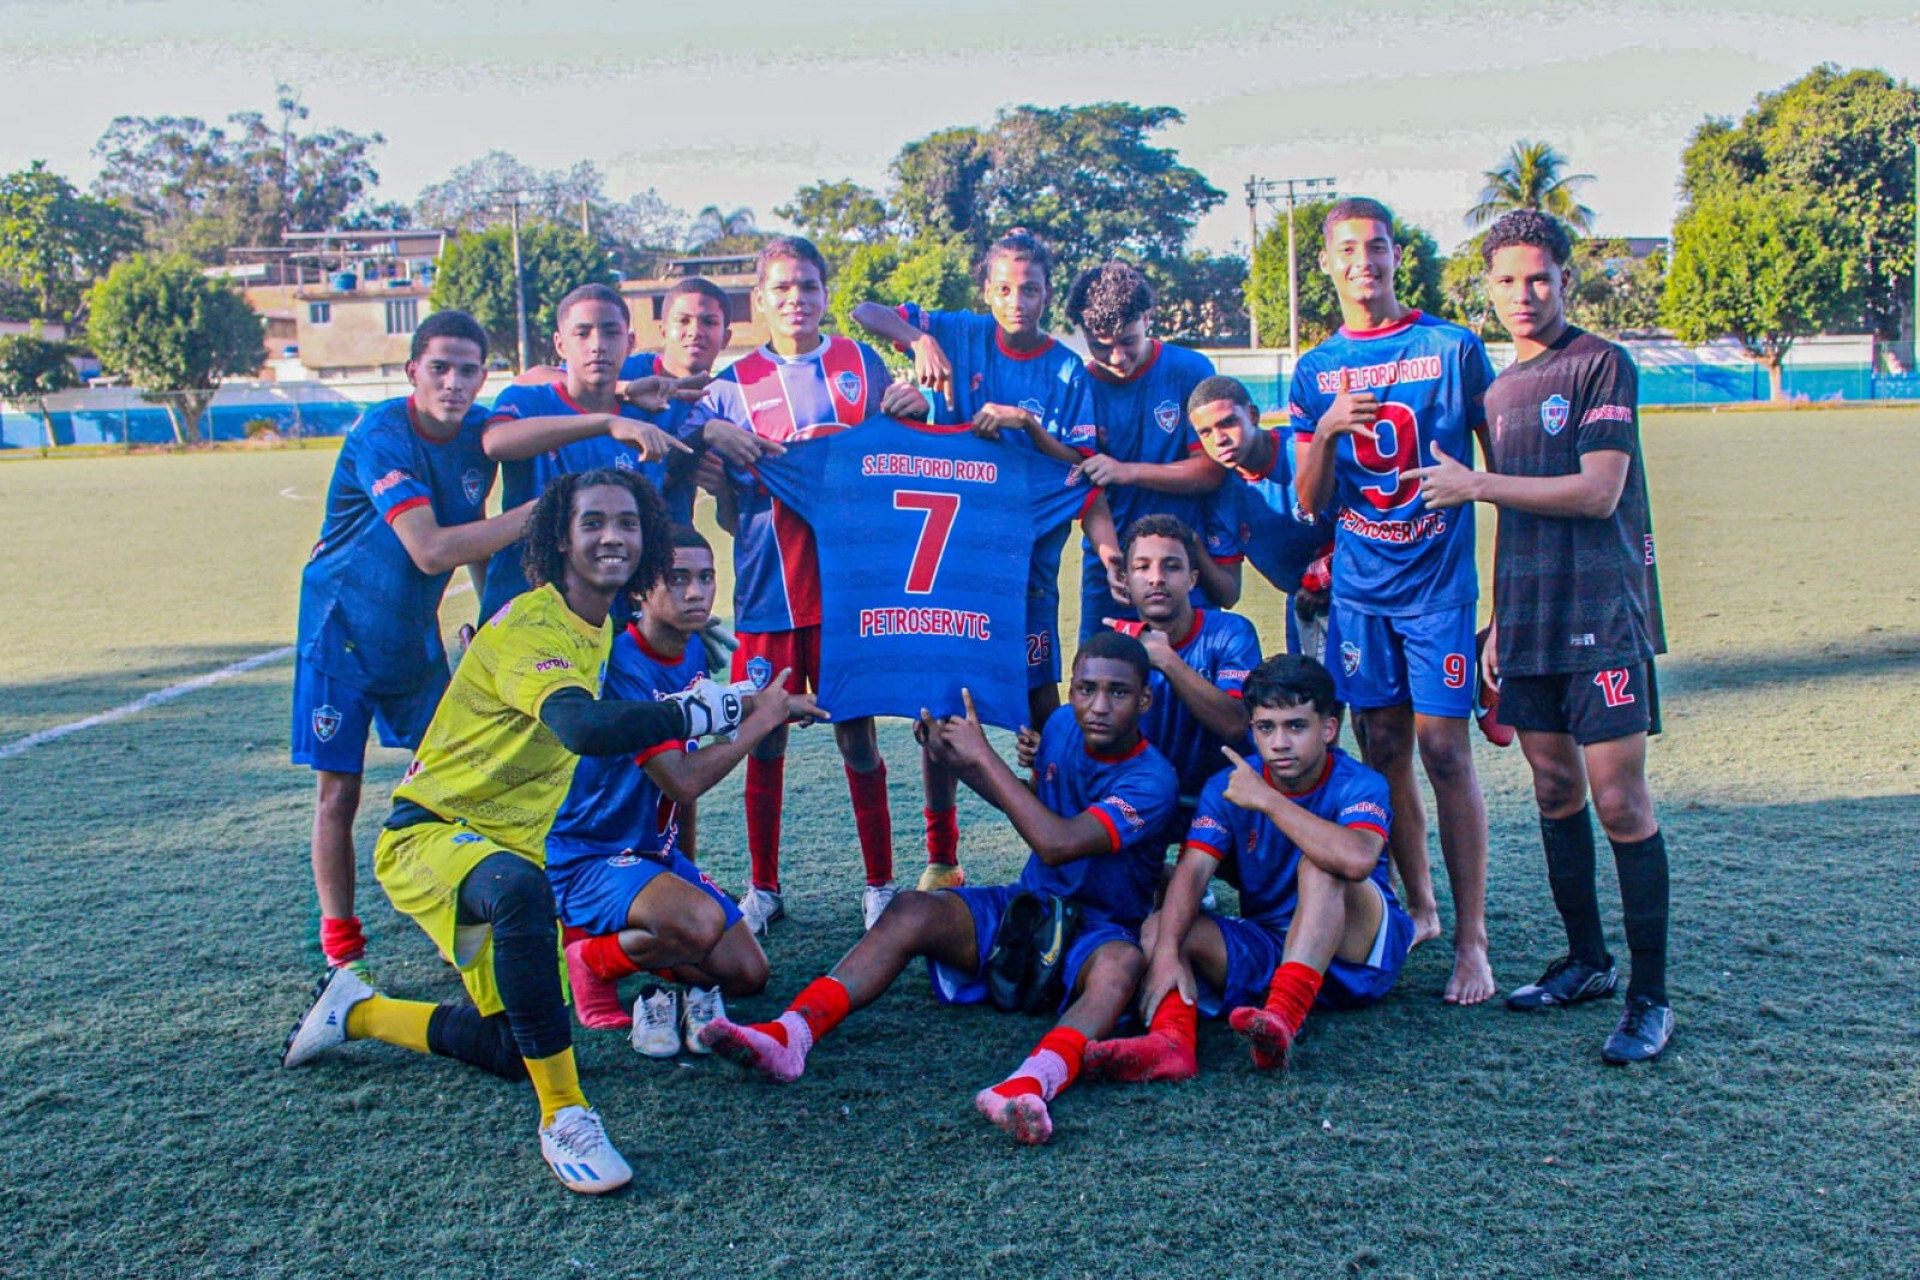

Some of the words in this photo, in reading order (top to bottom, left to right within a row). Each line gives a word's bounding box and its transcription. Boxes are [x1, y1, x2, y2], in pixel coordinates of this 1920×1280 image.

[1399, 355, 1442, 383] ROXO
[862, 453, 954, 480] S.E.BELFORD
[954, 459, 997, 484] ROXO
[1350, 401, 1422, 512] 9
[893, 489, 961, 594] 7
[860, 606, 990, 640] PETROSERVTC
[1026, 630, 1052, 666] 26
[1443, 652, 1467, 689] 9
[1593, 667, 1635, 707] 12
